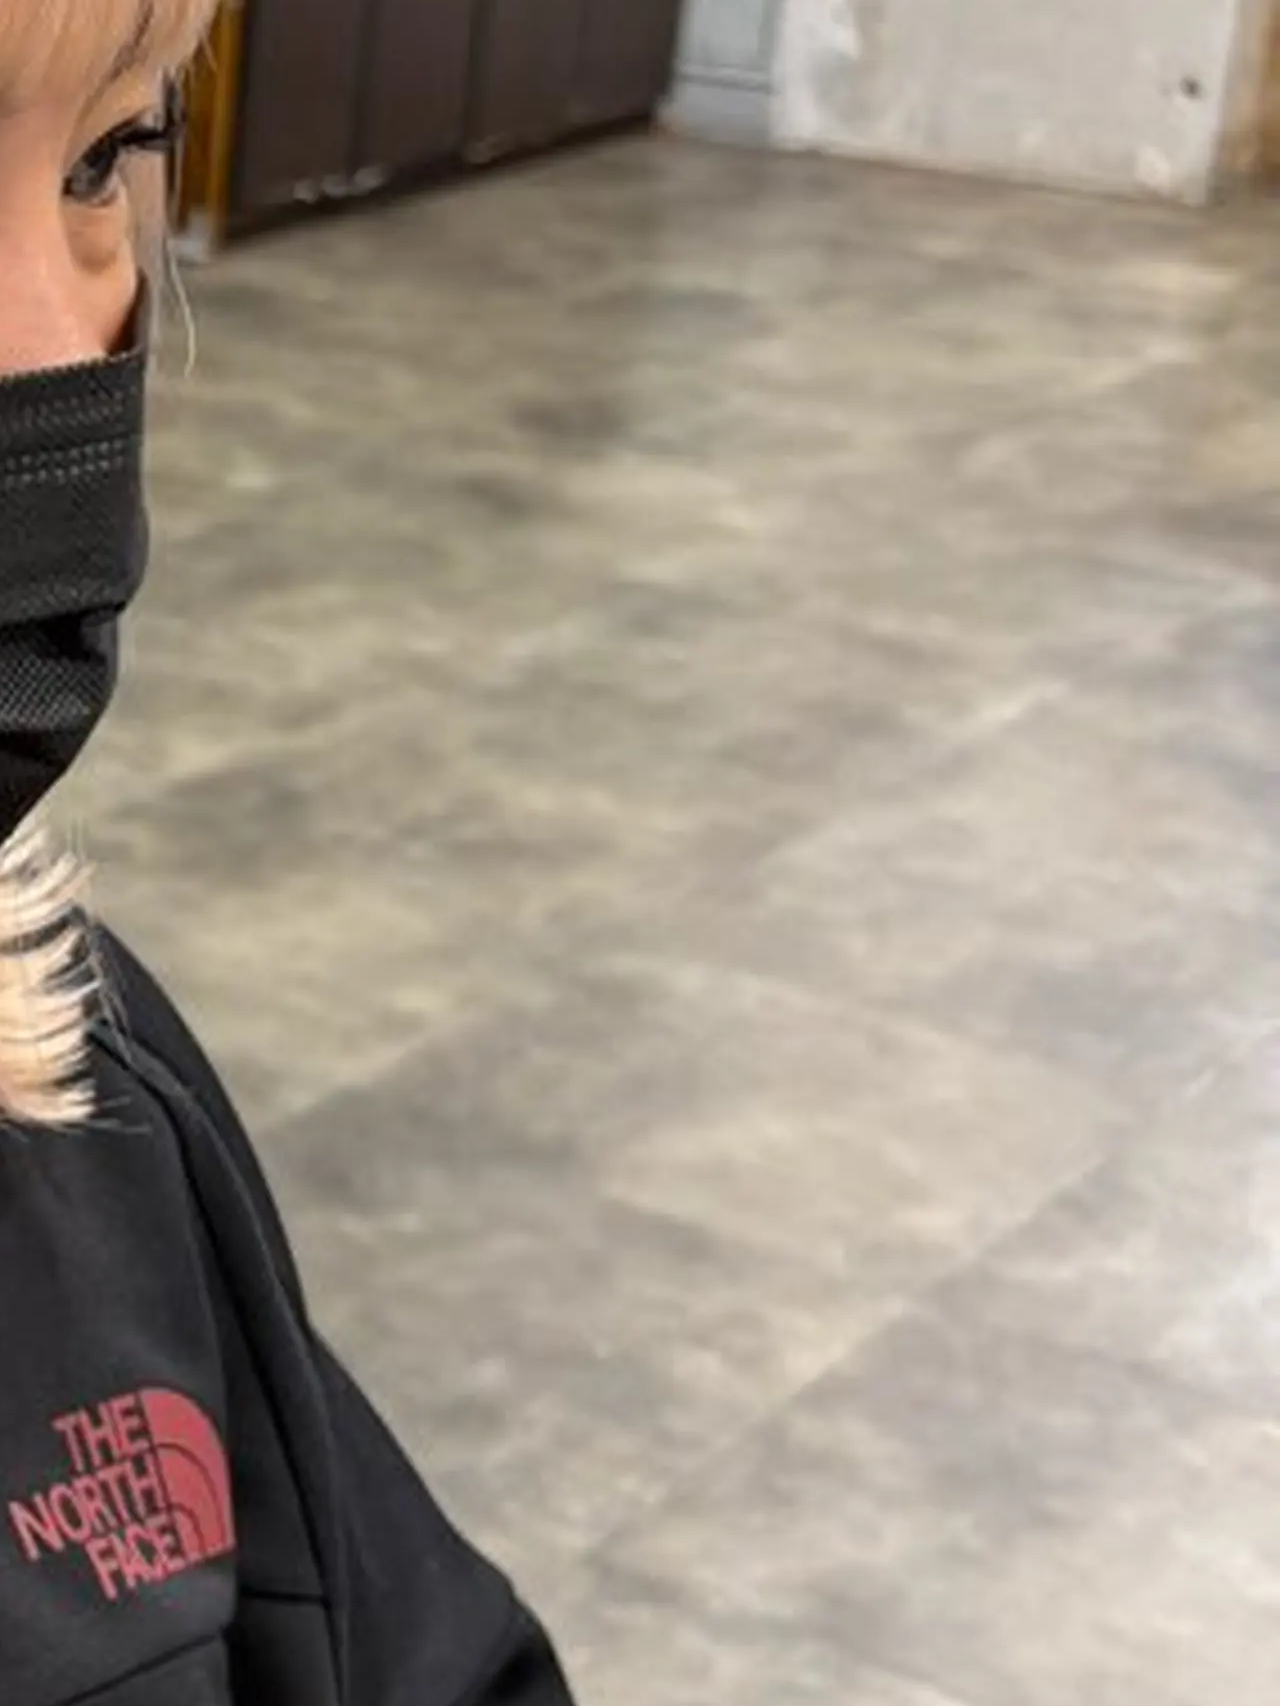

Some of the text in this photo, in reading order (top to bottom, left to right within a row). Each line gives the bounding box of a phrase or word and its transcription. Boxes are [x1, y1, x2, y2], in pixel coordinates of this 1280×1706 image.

[52, 1395, 150, 1472] THE
[7, 1453, 167, 1562] NORTH
[85, 1512, 185, 1600] FACE
